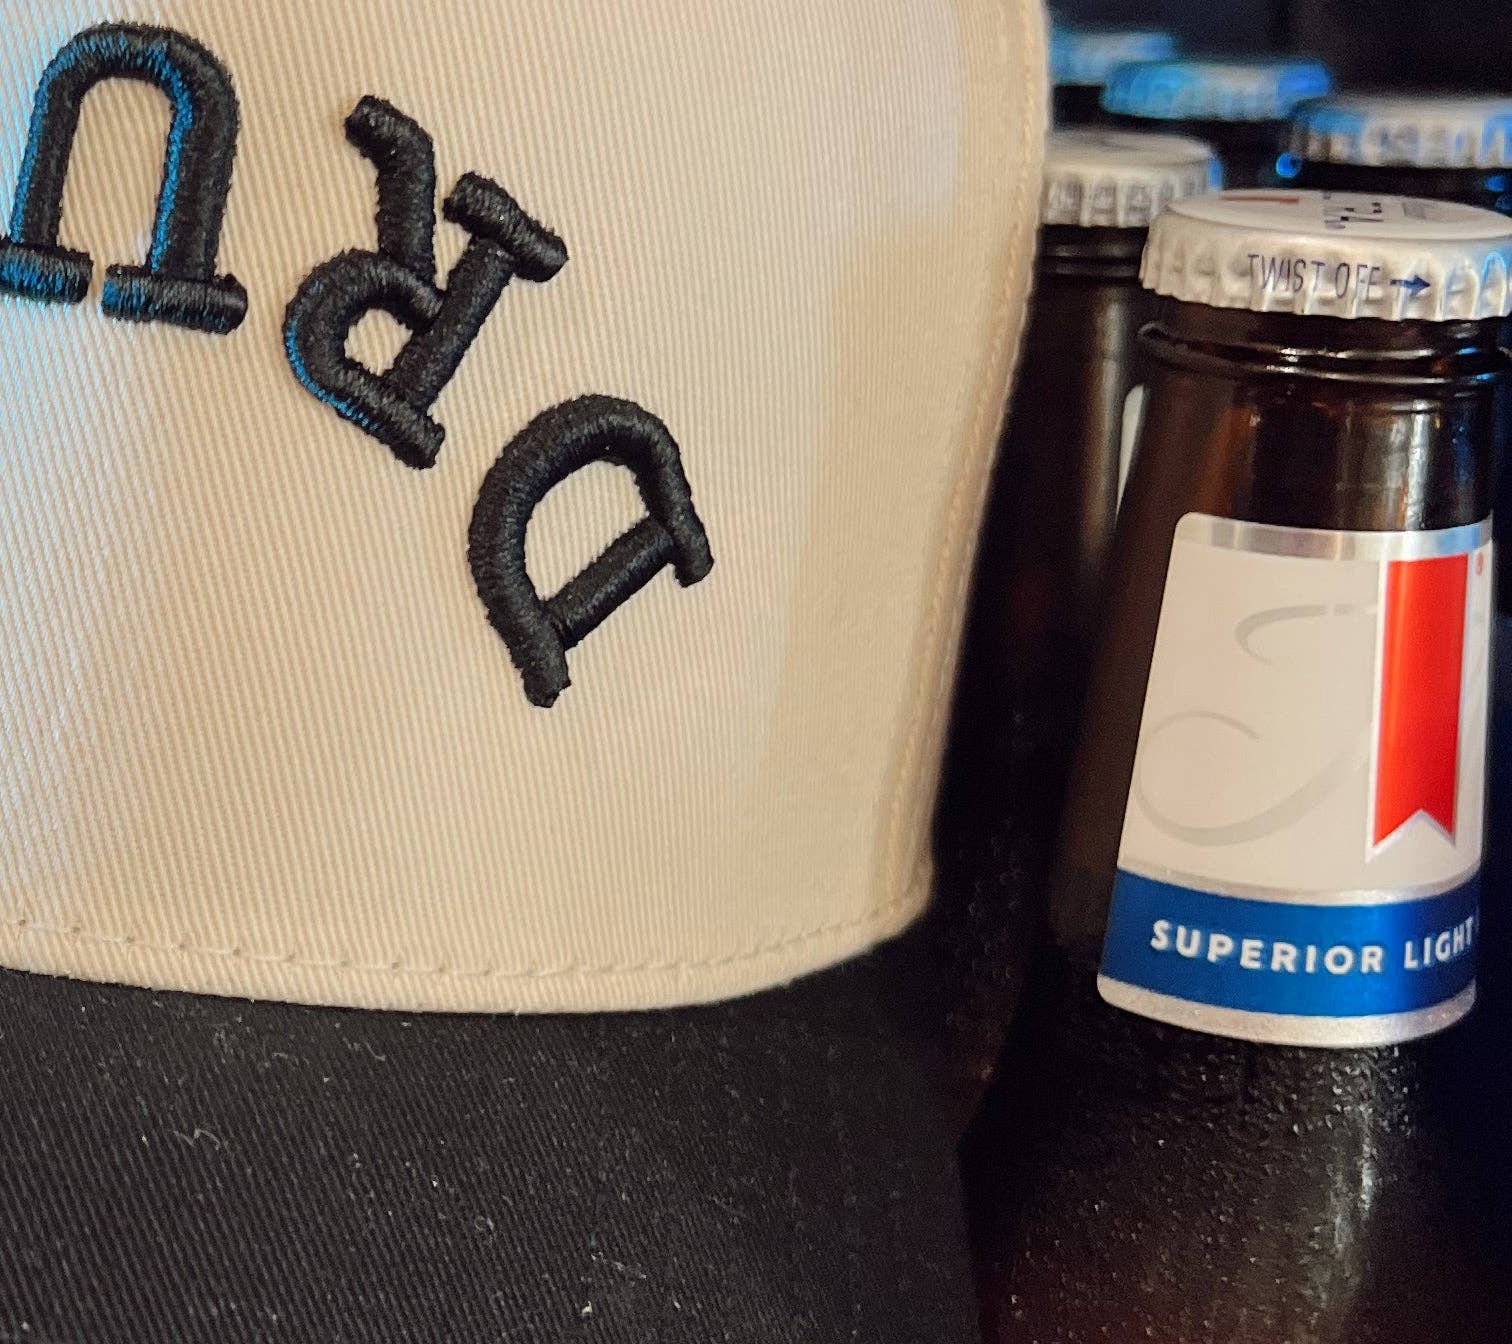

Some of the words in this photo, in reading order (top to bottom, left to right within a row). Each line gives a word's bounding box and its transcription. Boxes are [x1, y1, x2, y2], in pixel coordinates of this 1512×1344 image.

[1248, 253, 1326, 298] TWIST
[1335, 262, 1381, 298] OFF
[1150, 919, 1385, 975] SUPERIOR
[1403, 915, 1475, 971] LIGHT
